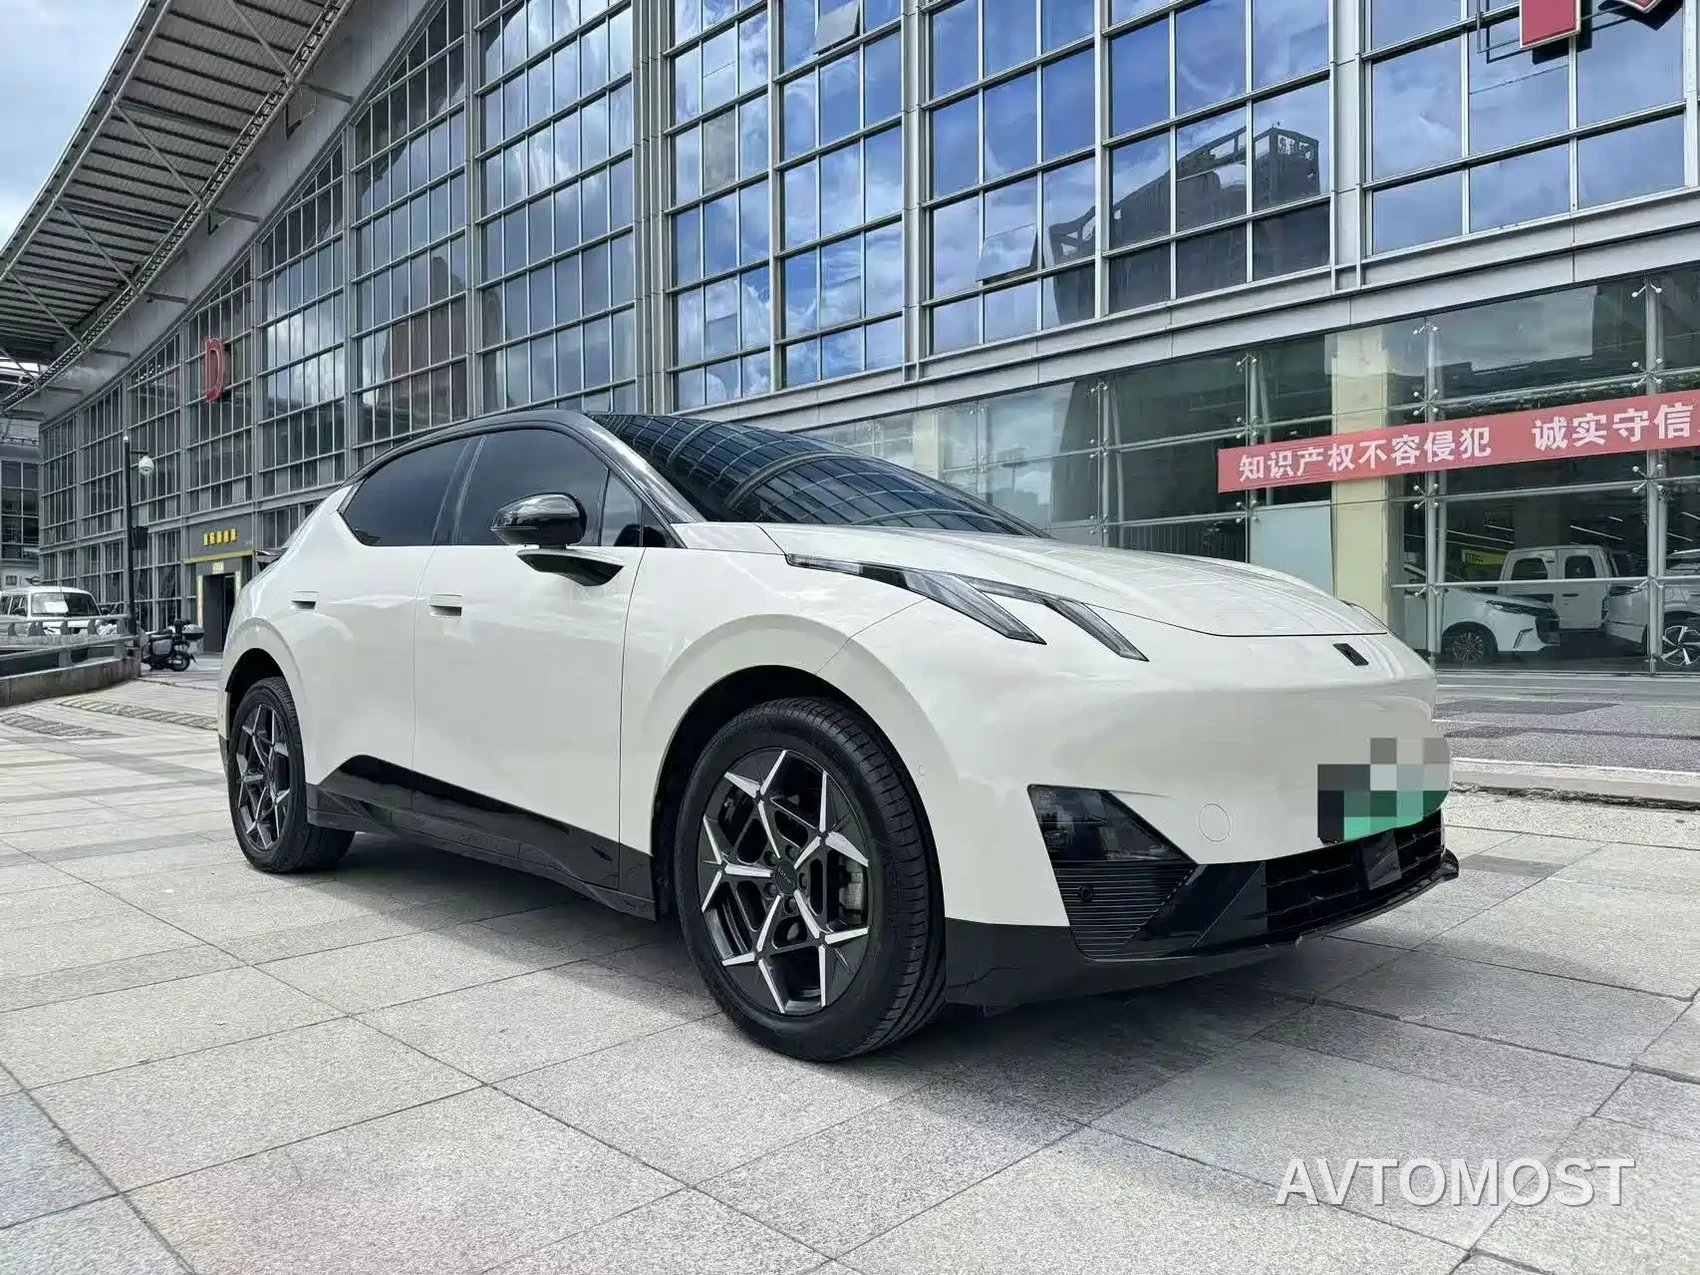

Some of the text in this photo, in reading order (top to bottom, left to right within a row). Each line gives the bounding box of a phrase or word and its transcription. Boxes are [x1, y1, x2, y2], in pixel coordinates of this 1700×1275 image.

[205, 338, 223, 402] D
[1239, 402, 1693, 482] 知识产权不容侵犯 诚实守信
